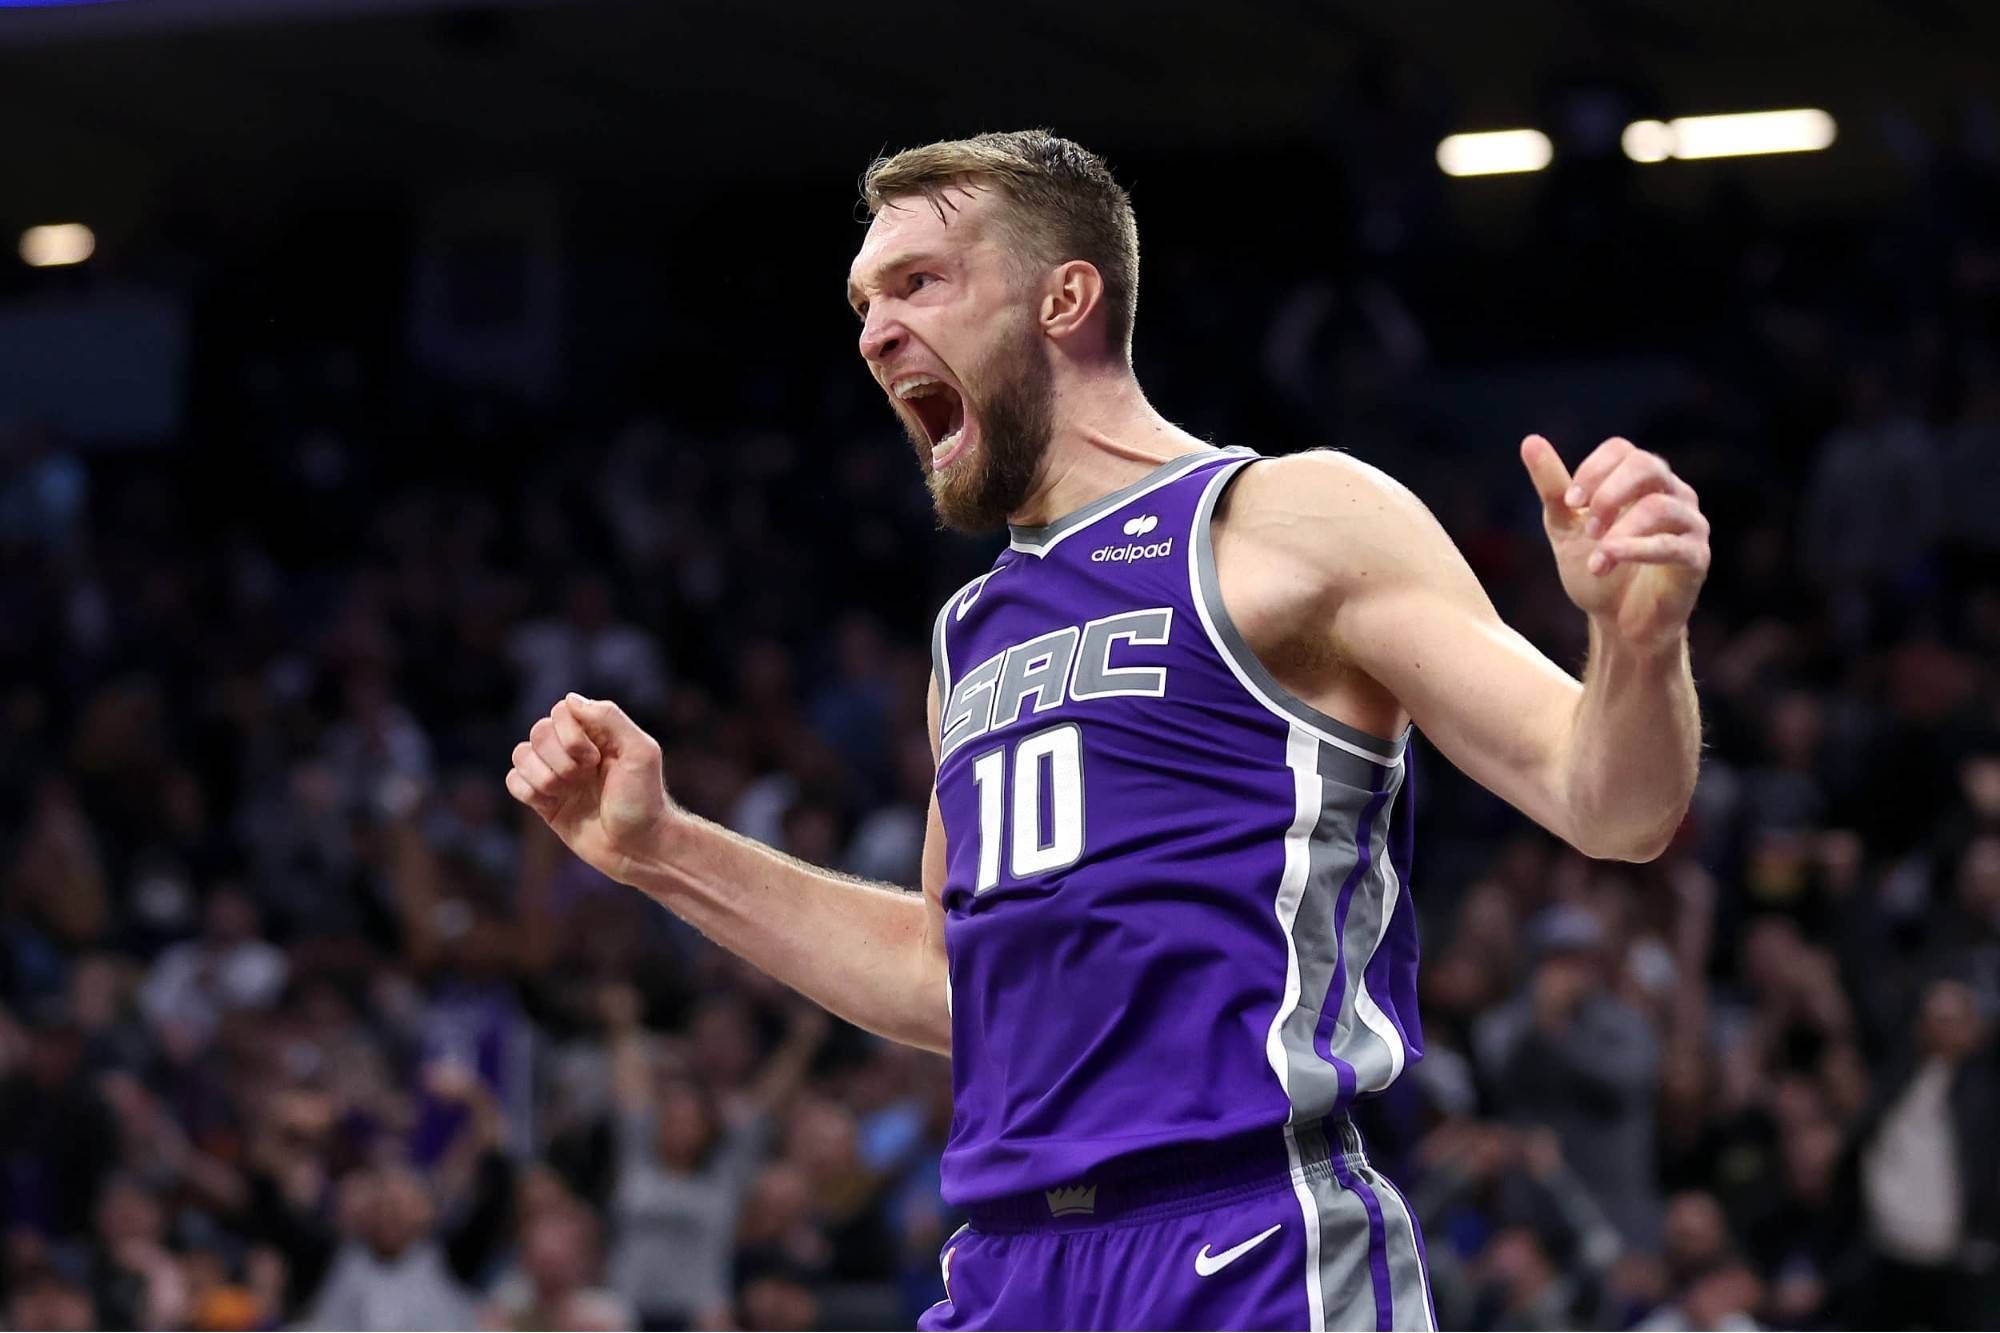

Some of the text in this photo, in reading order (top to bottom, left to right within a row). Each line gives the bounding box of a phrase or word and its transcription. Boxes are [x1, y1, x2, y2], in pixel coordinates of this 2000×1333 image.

[1091, 537, 1173, 564] dialpad
[939, 607, 1173, 767] SAC
[972, 721, 1086, 896] 10
